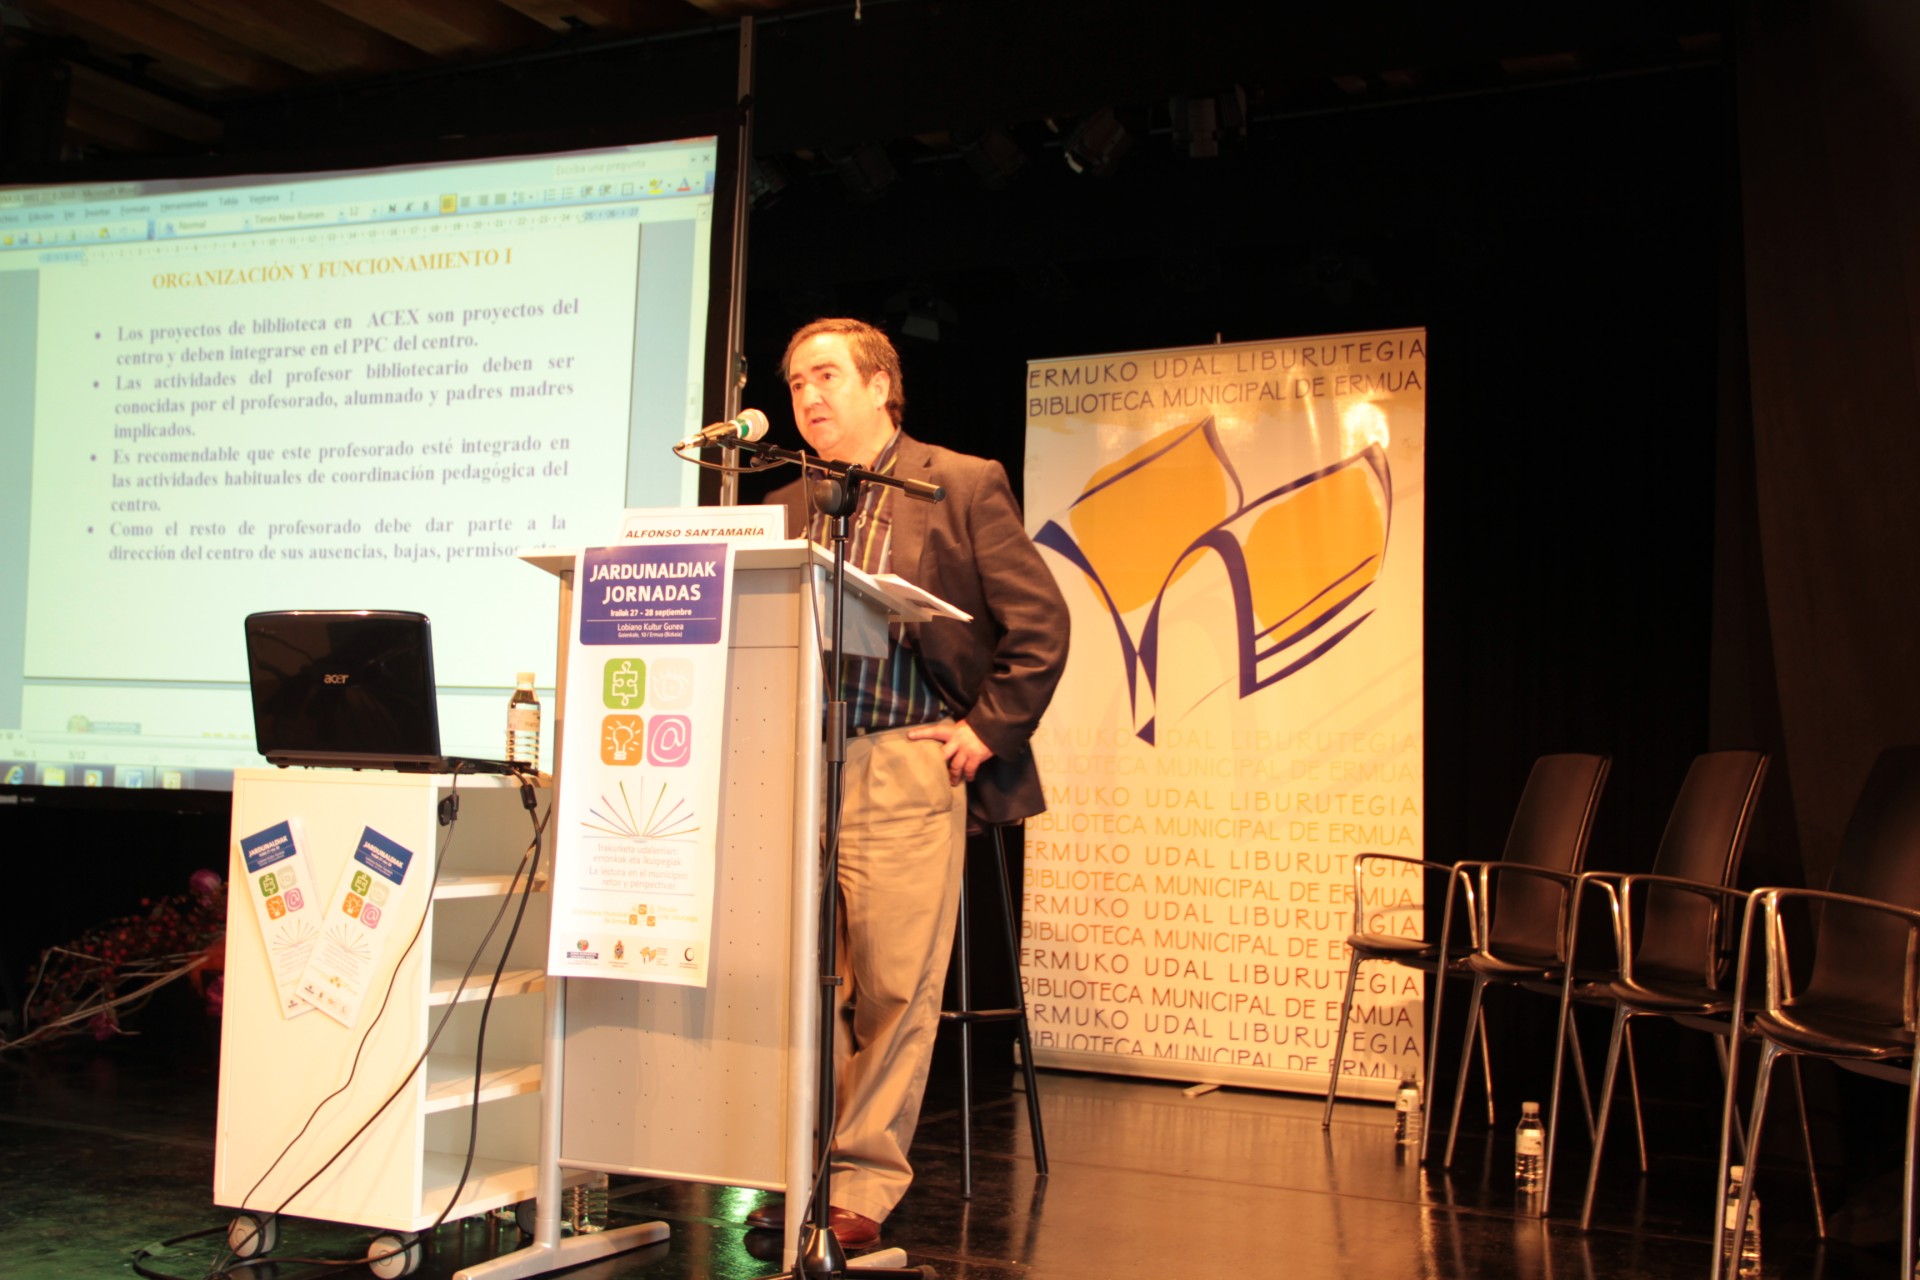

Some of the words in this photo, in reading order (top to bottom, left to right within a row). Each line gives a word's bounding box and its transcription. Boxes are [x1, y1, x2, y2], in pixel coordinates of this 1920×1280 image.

[153, 261, 294, 289] ORGANIZACIÓN
[302, 264, 314, 279] Y
[318, 249, 500, 279] FUNCIONAMIENTO
[505, 248, 513, 265] I
[118, 326, 143, 342] Los
[150, 324, 222, 344] proyectos
[229, 321, 245, 336] de
[253, 317, 326, 334] biblioteca
[335, 317, 352, 330] en
[367, 309, 420, 328] ACEX
[428, 311, 454, 324] son
[463, 303, 544, 326] proyectos
[553, 298, 579, 315] del
[117, 351, 163, 365] centro
[168, 352, 175, 368] y
[181, 346, 224, 363] deben
[230, 342, 305, 363] integrarse
[311, 344, 328, 357] en
[334, 340, 347, 355] el
[352, 336, 388, 354] PPC
[393, 335, 417, 351] del
[422, 335, 478, 350] centro.
[1029, 361, 1138, 388] ERMUKO
[1154, 356, 1222, 379] UDAL
[1237, 338, 1425, 373] LIBURUTEGIA
[116, 375, 141, 391] Las
[154, 371, 236, 390] actividades
[249, 370, 272, 386] del
[286, 367, 352, 388] profesor
[367, 359, 468, 380] bibliotecario
[483, 356, 533, 373] deben
[548, 355, 575, 369] ser
[115, 399, 186, 415] conocidas
[191, 400, 214, 418] por
[223, 396, 235, 411] el
[240, 393, 338, 415] profesorado,
[344, 386, 422, 406] alumnado
[429, 389, 439, 406] y
[446, 383, 503, 405] padres
[510, 380, 574, 398] madres
[1029, 390, 1154, 417] BIBLIOTECA
[1163, 379, 1285, 408] MUNICIPAL
[1296, 377, 1324, 399] DE
[1336, 370, 1422, 396] ERMUA
[114, 422, 196, 442] implicados.
[114, 449, 130, 464] Es
[137, 446, 240, 464] recomendable
[248, 449, 274, 465] que
[282, 445, 311, 460] este
[318, 440, 414, 463] profesorado
[422, 438, 453, 455] esté
[461, 436, 541, 457] integrado
[550, 438, 570, 450] en
[112, 473, 131, 488] las
[137, 471, 218, 488] actividades
[224, 470, 301, 487] habituales
[308, 469, 325, 483] de
[332, 464, 434, 484] coordinación
[442, 462, 535, 484] pedagógica
[543, 460, 568, 477] del
[111, 498, 161, 512] centro.
[110, 522, 153, 536] Como
[165, 521, 178, 536] el
[190, 522, 226, 536] resto
[239, 520, 255, 535] de
[268, 519, 361, 540] profesorado
[374, 519, 412, 534] debe
[426, 517, 454, 533] dar
[468, 517, 512, 536] parte
[527, 518, 536, 531] a
[552, 514, 566, 530] la
[625, 530, 681, 538] ALFONSO
[685, 525, 764, 537] SANTAMARÍA
[109, 545, 175, 561] dirección
[181, 546, 202, 560] del
[207, 548, 253, 560] centro
[259, 545, 276, 560] de
[281, 549, 304, 560] sus
[309, 544, 388, 561] ausencias,
[394, 543, 440, 562] bajas,
[590, 562, 716, 582] JARDUNALDIAK
[603, 584, 701, 604] JORNADAS
[630, 609, 639, 617] 27
[655, 608, 692, 617] septiembre
[324, 674, 348, 684] acer
[1146, 789, 1214, 810] UDAL
[1230, 792, 1418, 817] LIBURUTEGIA
[1023, 812, 1147, 834] BIBLIOTECA
[1155, 817, 1280, 841] MUNICIPAL
[1290, 821, 1318, 842] DE
[1329, 822, 1414, 846] ERMUA
[1023, 840, 1130, 864] ERMUKO
[1145, 847, 1214, 868] UDAL
[1230, 850, 1418, 878] LIBURUTGIA
[1023, 868, 1148, 893] BIBLIOTECA
[1155, 875, 1280, 898] MUNICIPAL
[1290, 883, 1318, 904] DE
[1328, 883, 1412, 909] ERMUA
[1022, 893, 1129, 918] ERMUKO
[1145, 901, 1214, 923] UDAL
[1229, 905, 1418, 936] LIBURUTGIA
[1021, 920, 1145, 946] BIBLIOTECA
[1154, 929, 1279, 956] MUNICIPAL
[1289, 937, 1318, 958] DE
[1019, 948, 1129, 974] ERMUKO
[1145, 957, 1214, 980] UDAL
[1229, 962, 1419, 995] LIBURUTEGIA
[1020, 976, 1143, 1003] BIBLIOTECA
[1153, 987, 1275, 1015] MUNICIPAL
[1285, 998, 1315, 1019] DE
[1326, 1001, 1412, 1027] EMUA
[1145, 1013, 1213, 1037] UDAL
[1032, 1030, 1144, 1055] IBLIOTECA
